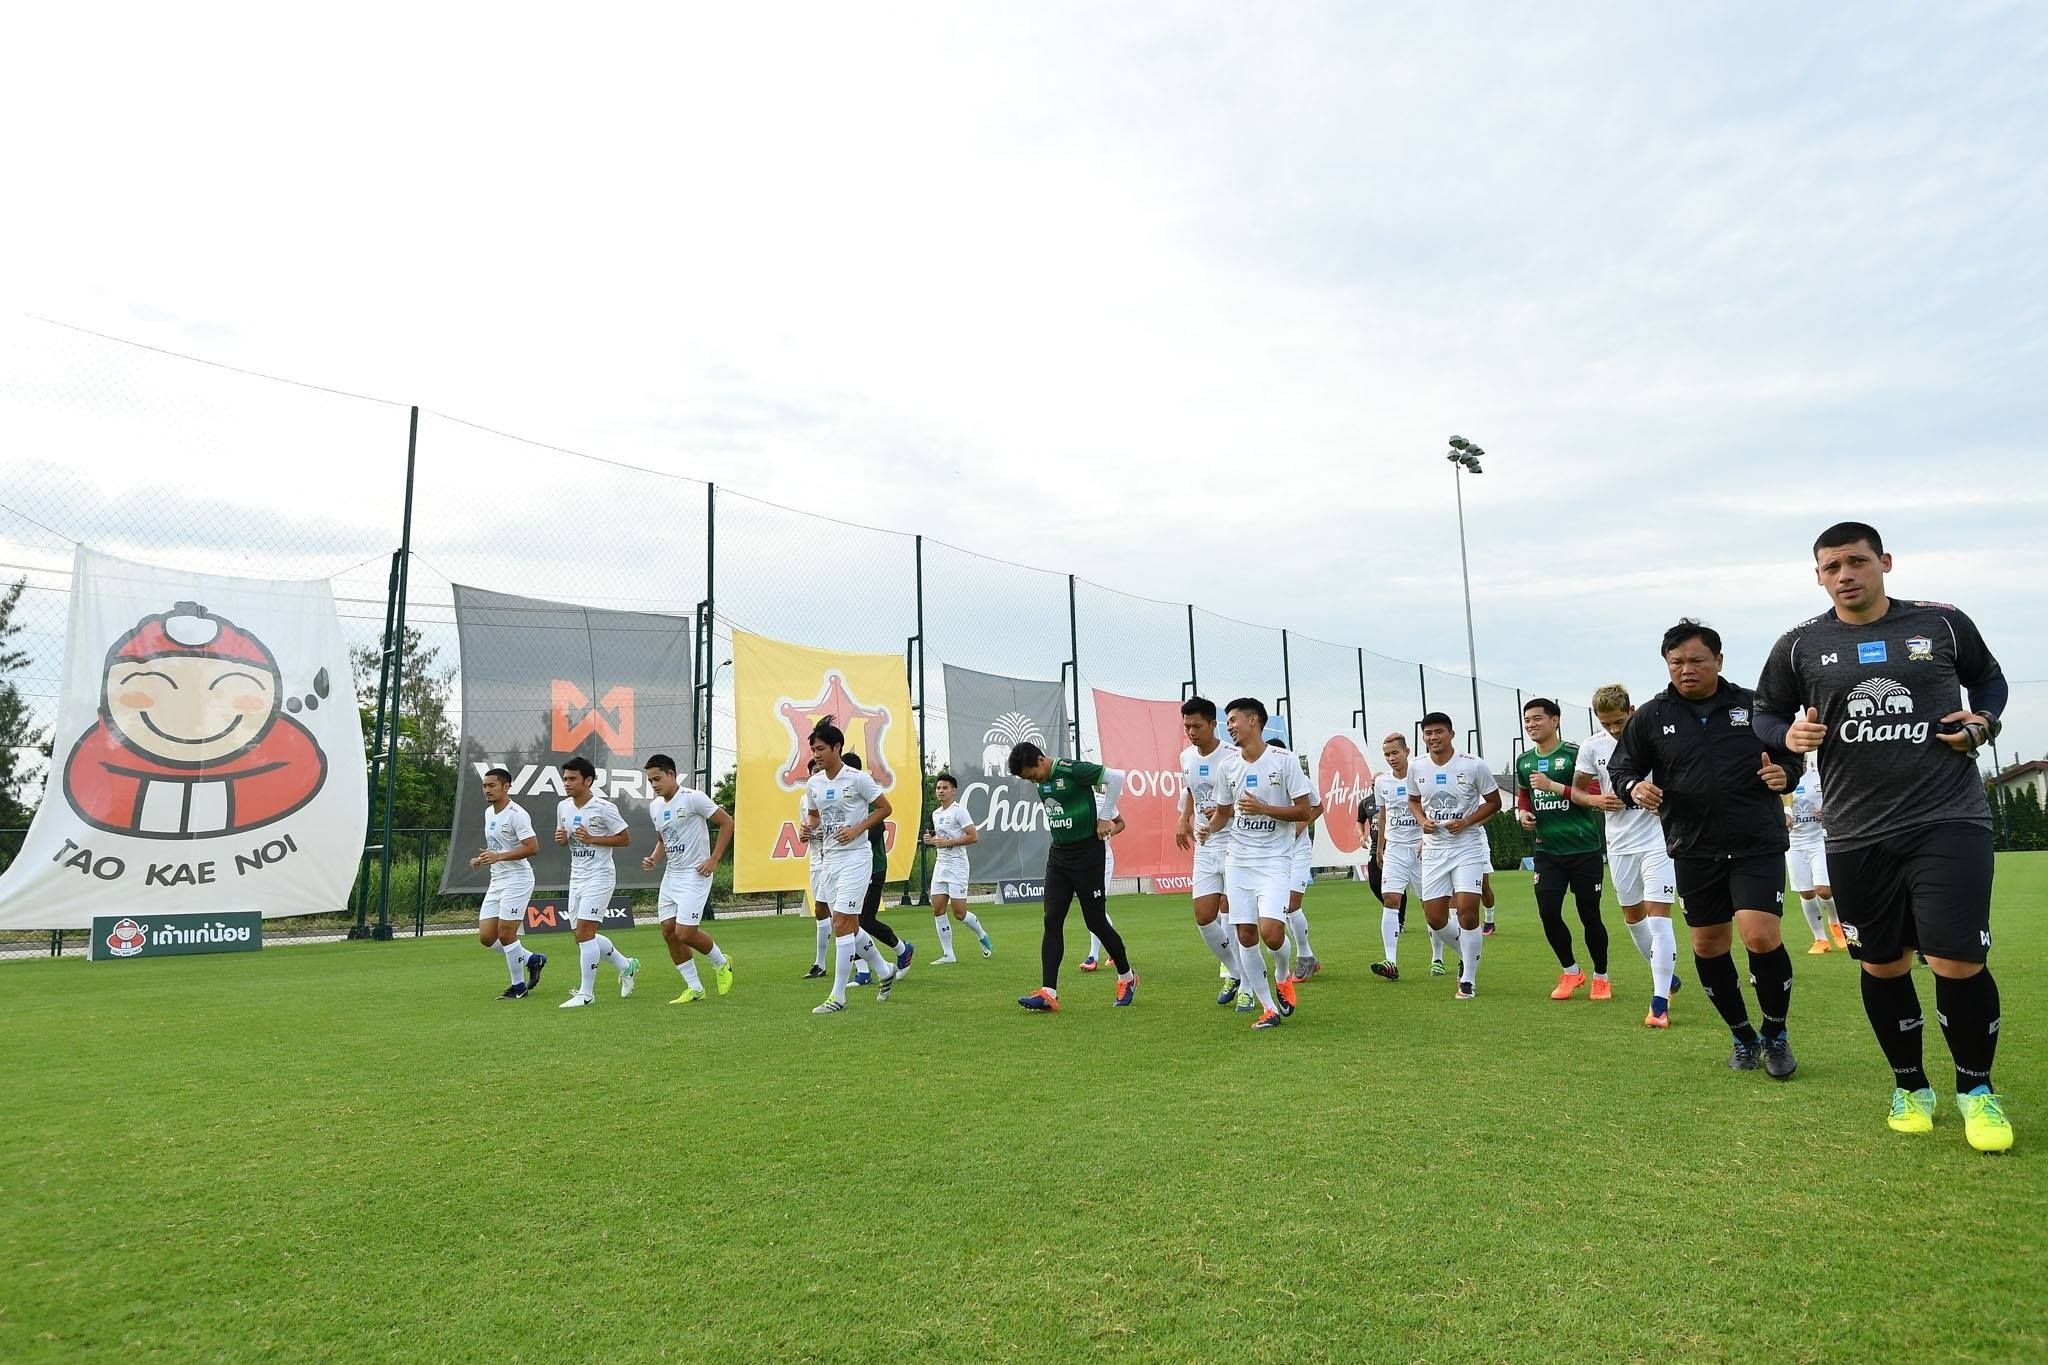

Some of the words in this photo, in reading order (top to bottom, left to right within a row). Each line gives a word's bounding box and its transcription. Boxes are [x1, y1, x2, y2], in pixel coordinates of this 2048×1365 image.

[1839, 719, 1930, 744] Chang
[473, 761, 688, 800] WARRI
[1118, 768, 1184, 798] OYOT
[959, 782, 1051, 832] Chan
[1534, 798, 1570, 811] Chang
[1048, 816, 1073, 829] hang
[1237, 817, 1276, 832] Chang
[665, 844, 685, 854] ang
[52, 838, 126, 880] TAO
[145, 861, 216, 887] KAE
[234, 833, 298, 875] NOI
[1018, 882, 1045, 898] Chan
[1156, 876, 1193, 889] TOYOTA
[558, 907, 628, 920] WRIX
[152, 922, 250, 946] เถ้าแก่น้อย
